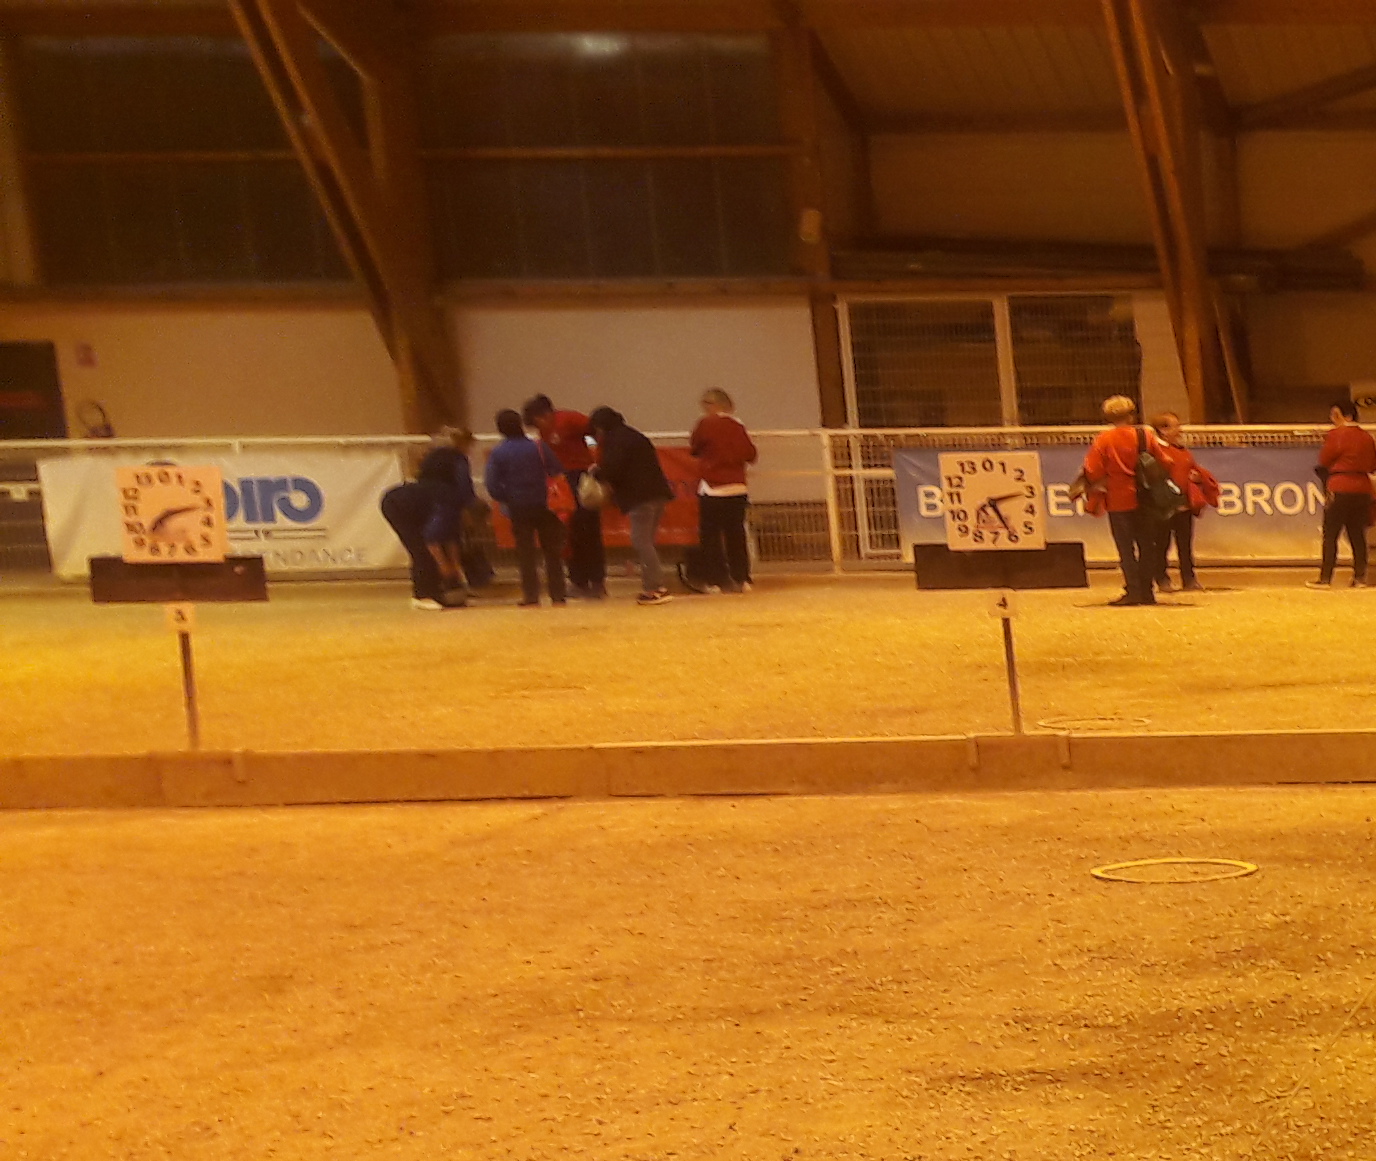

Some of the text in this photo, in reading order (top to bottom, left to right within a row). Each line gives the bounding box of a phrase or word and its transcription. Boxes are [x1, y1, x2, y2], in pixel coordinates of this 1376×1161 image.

[957, 460, 977, 475] 13
[982, 458, 995, 473] 0
[998, 461, 1007, 475] 1
[944, 475, 965, 489] 12
[1013, 468, 1026, 483] 2
[947, 491, 962, 505] 11
[1024, 485, 1036, 499] 3
[948, 509, 969, 522] 10
[1024, 503, 1037, 517] 4
[957, 525, 970, 538] 9
[972, 531, 985, 545] 8
[990, 532, 1001, 545] 7
[1007, 530, 1020, 544] 6
